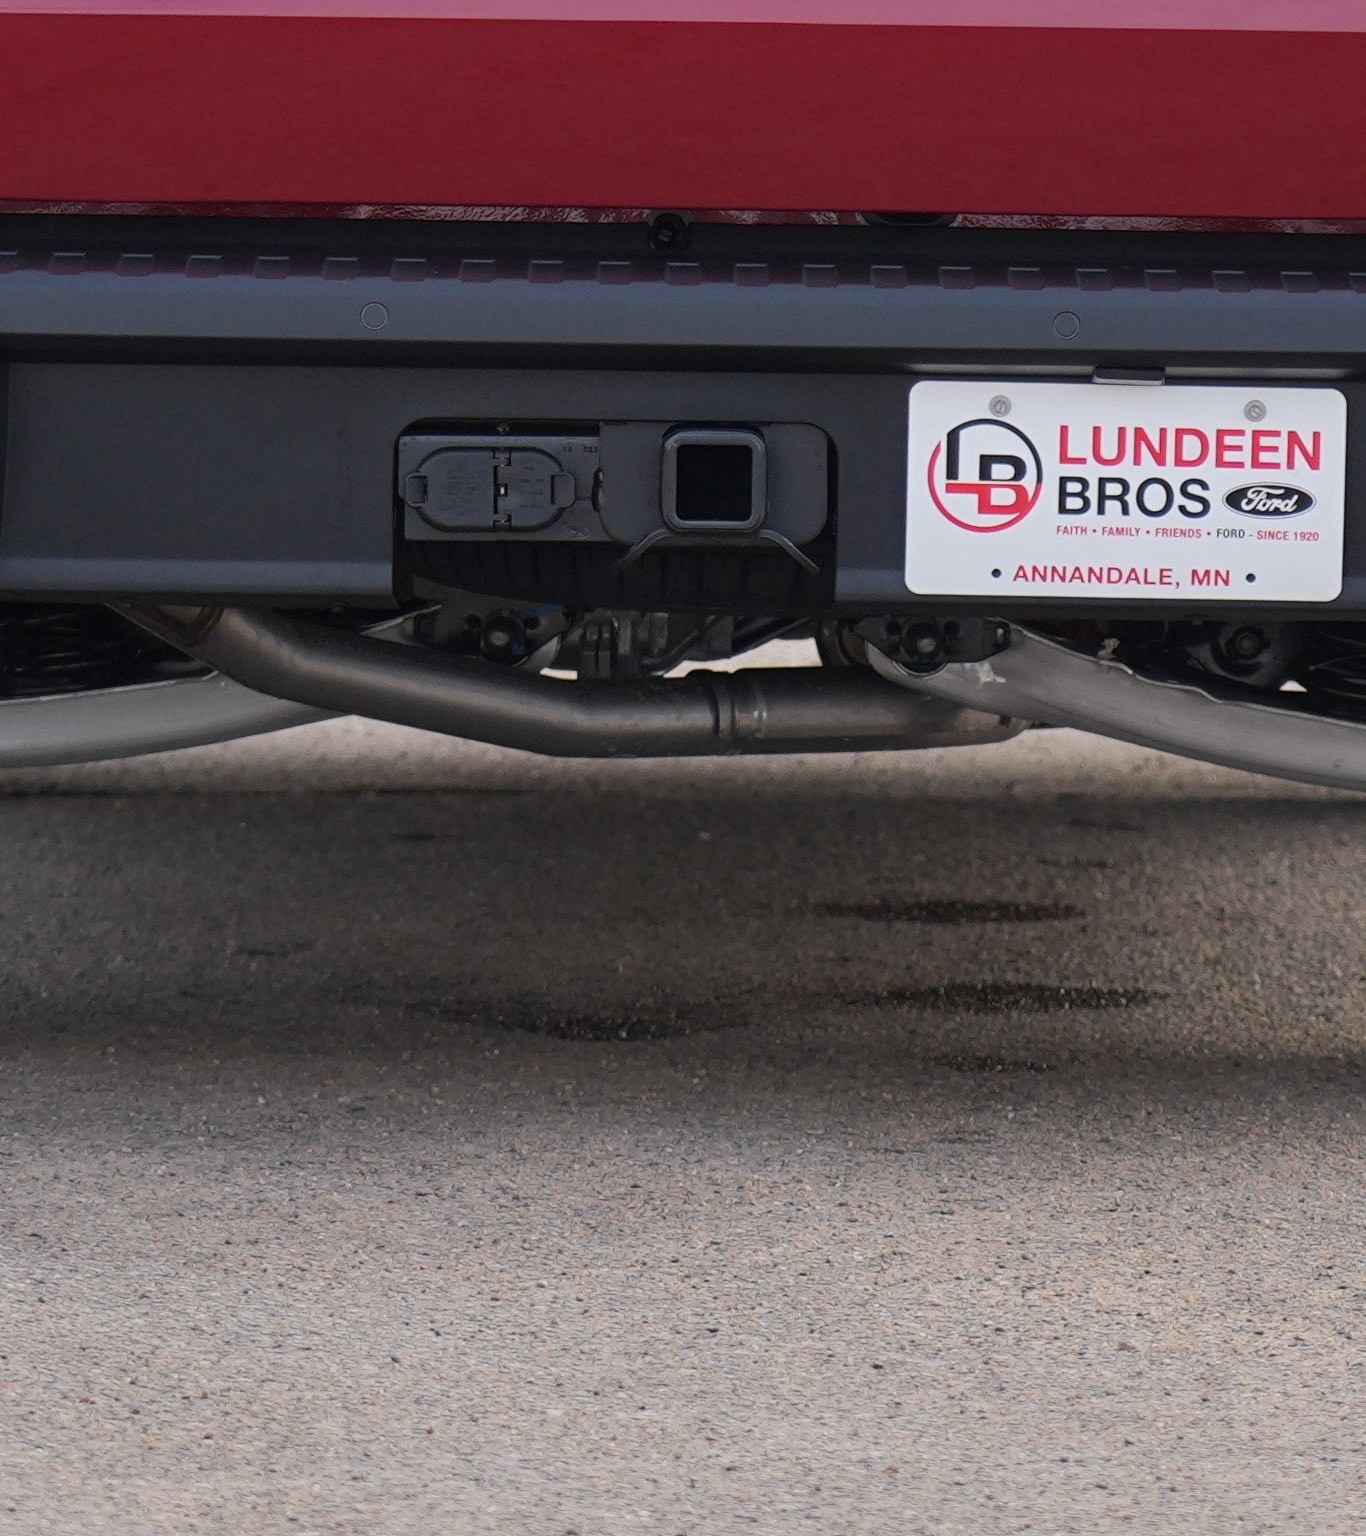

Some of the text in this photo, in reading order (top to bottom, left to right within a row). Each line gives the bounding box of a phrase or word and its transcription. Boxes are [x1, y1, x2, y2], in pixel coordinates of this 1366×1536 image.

[1058, 424, 1322, 471] LUNDEEN
[1058, 476, 1211, 519] BROS
[1239, 485, 1299, 514] Ford
[1056, 525, 1320, 542] FAITH FAMILY FRIENDS FORD SINCE 1920
[1012, 564, 1231, 589] ANNANDALE, MN
